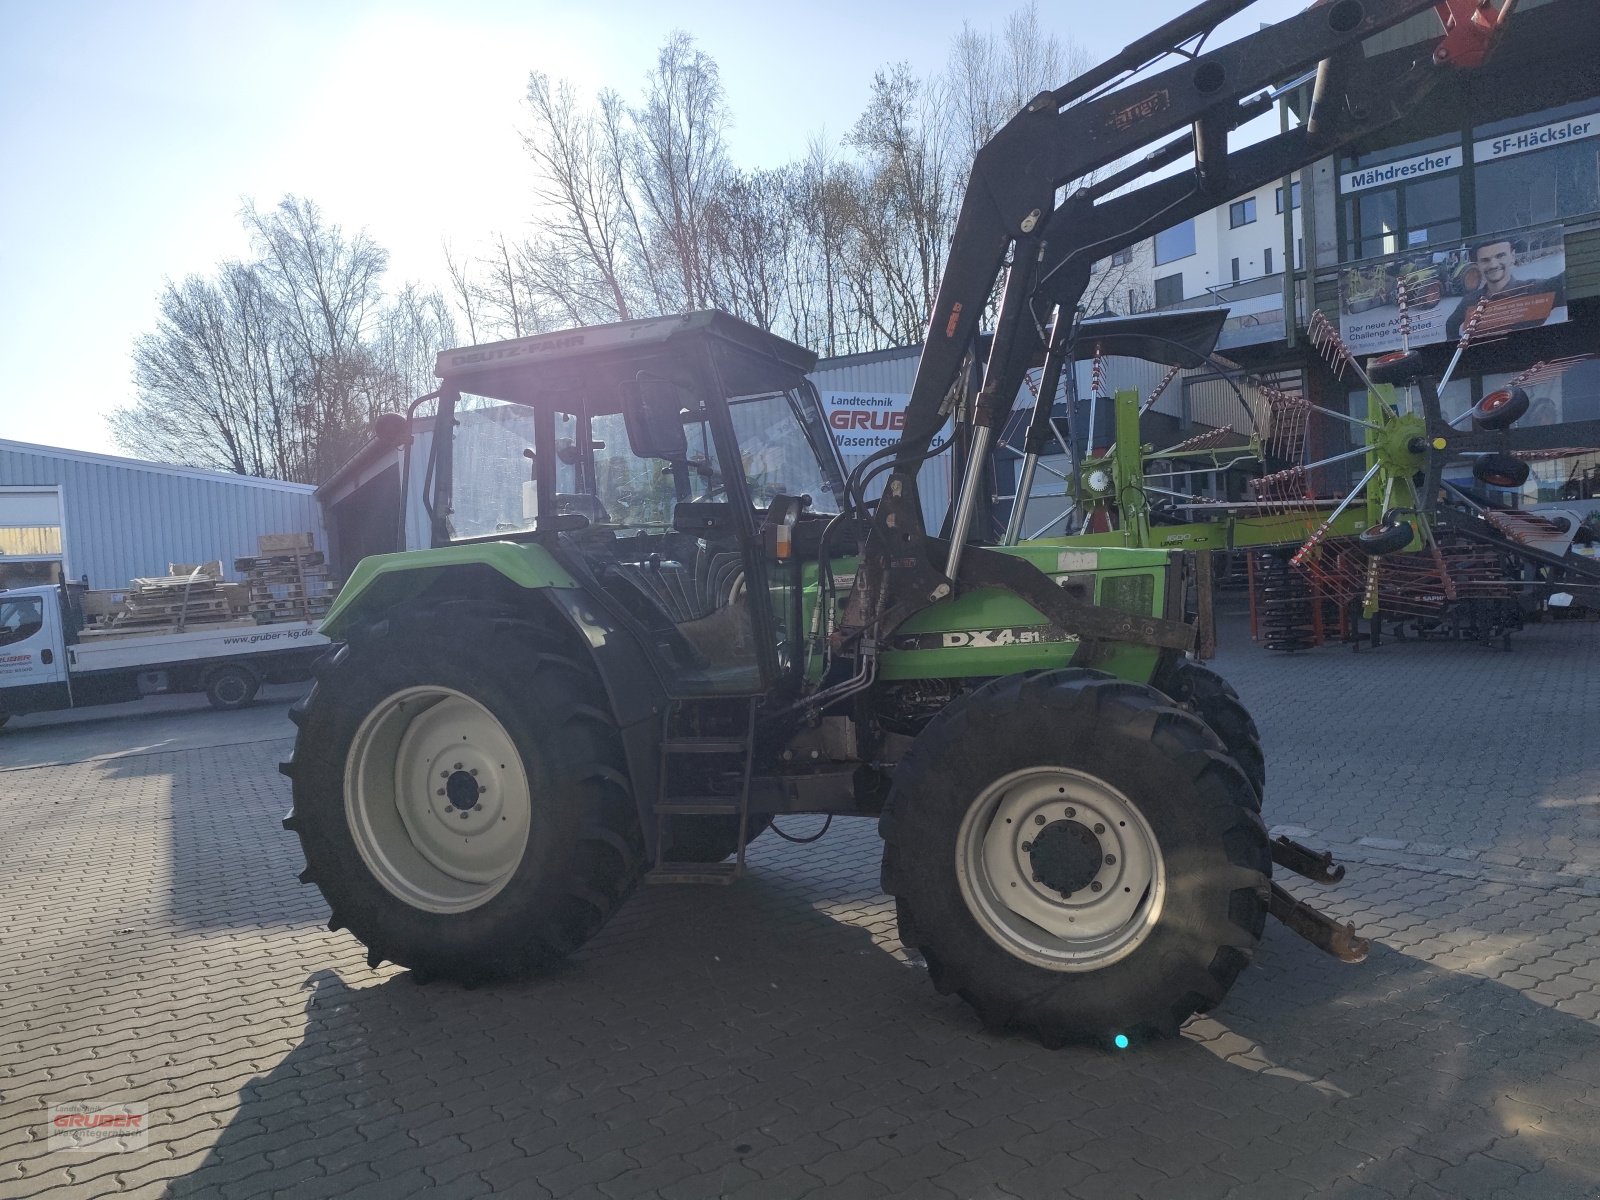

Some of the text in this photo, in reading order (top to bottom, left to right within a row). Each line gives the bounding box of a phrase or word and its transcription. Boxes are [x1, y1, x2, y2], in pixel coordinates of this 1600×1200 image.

[1492, 121, 1591, 155] SF-Häcksler
[1351, 154, 1452, 188] Mähdrescher
[1349, 325, 1364, 333] Der
[1366, 323, 1386, 331] neue
[1349, 328, 1390, 341] Challenge
[452, 335, 585, 366] DEUTZ-FAHR
[831, 396, 893, 406] Landtechnik
[829, 410, 906, 430] GRUB
